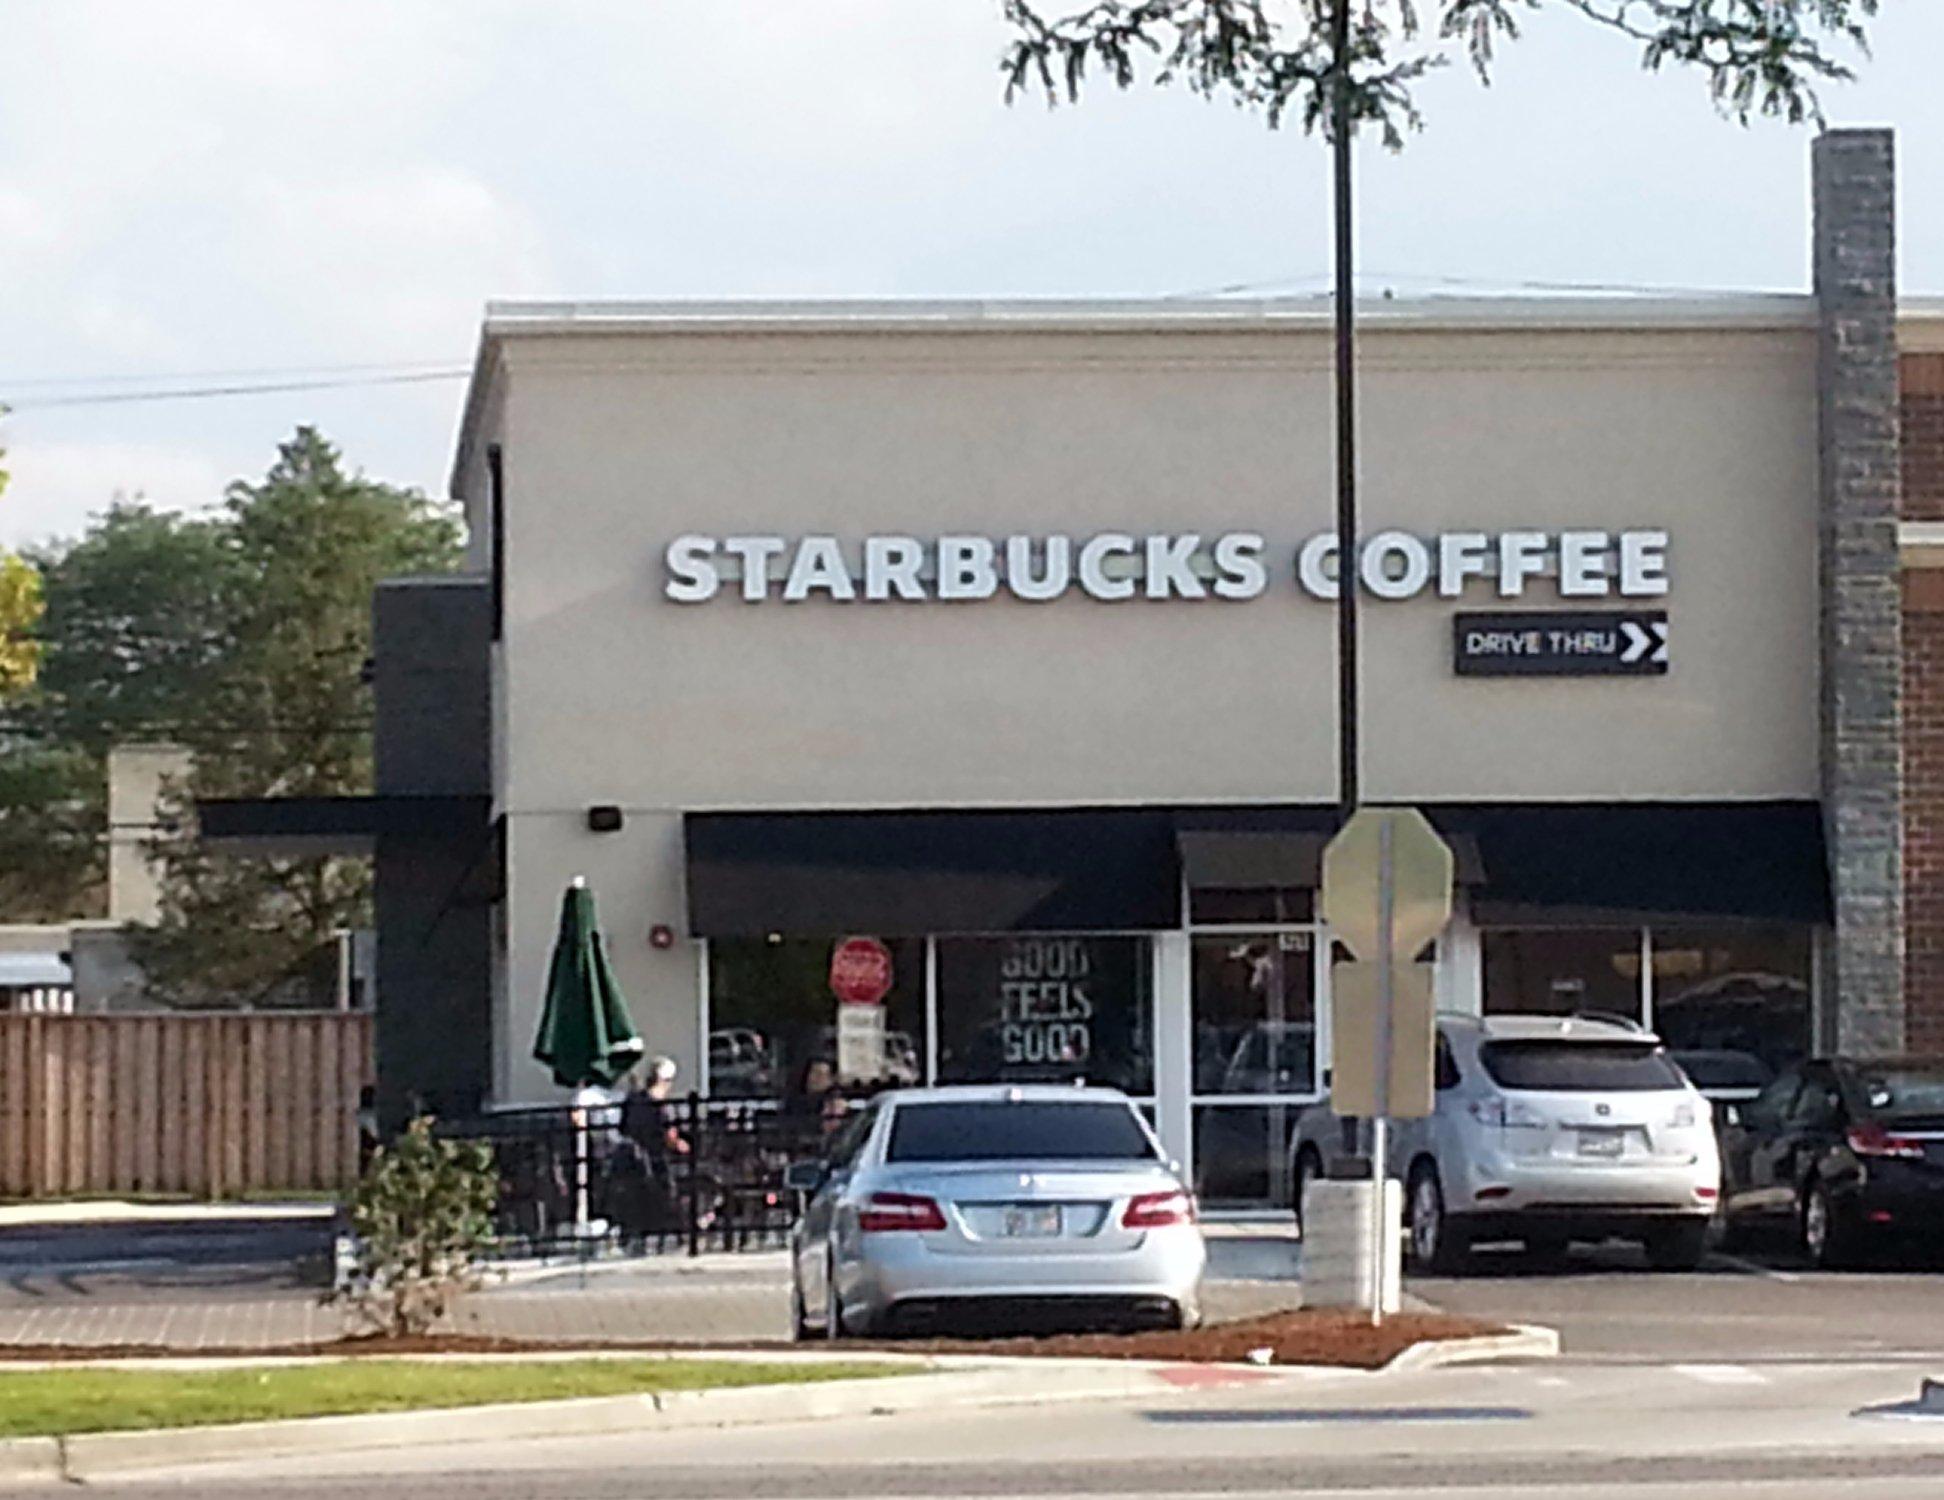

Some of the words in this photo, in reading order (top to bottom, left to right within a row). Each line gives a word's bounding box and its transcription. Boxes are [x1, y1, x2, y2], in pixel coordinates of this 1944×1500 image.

[665, 533, 1266, 602] STARBUCKS
[1299, 530, 1669, 599] COFFEE
[1466, 632, 1541, 654] DRIVE
[1549, 632, 1617, 654] THRU
